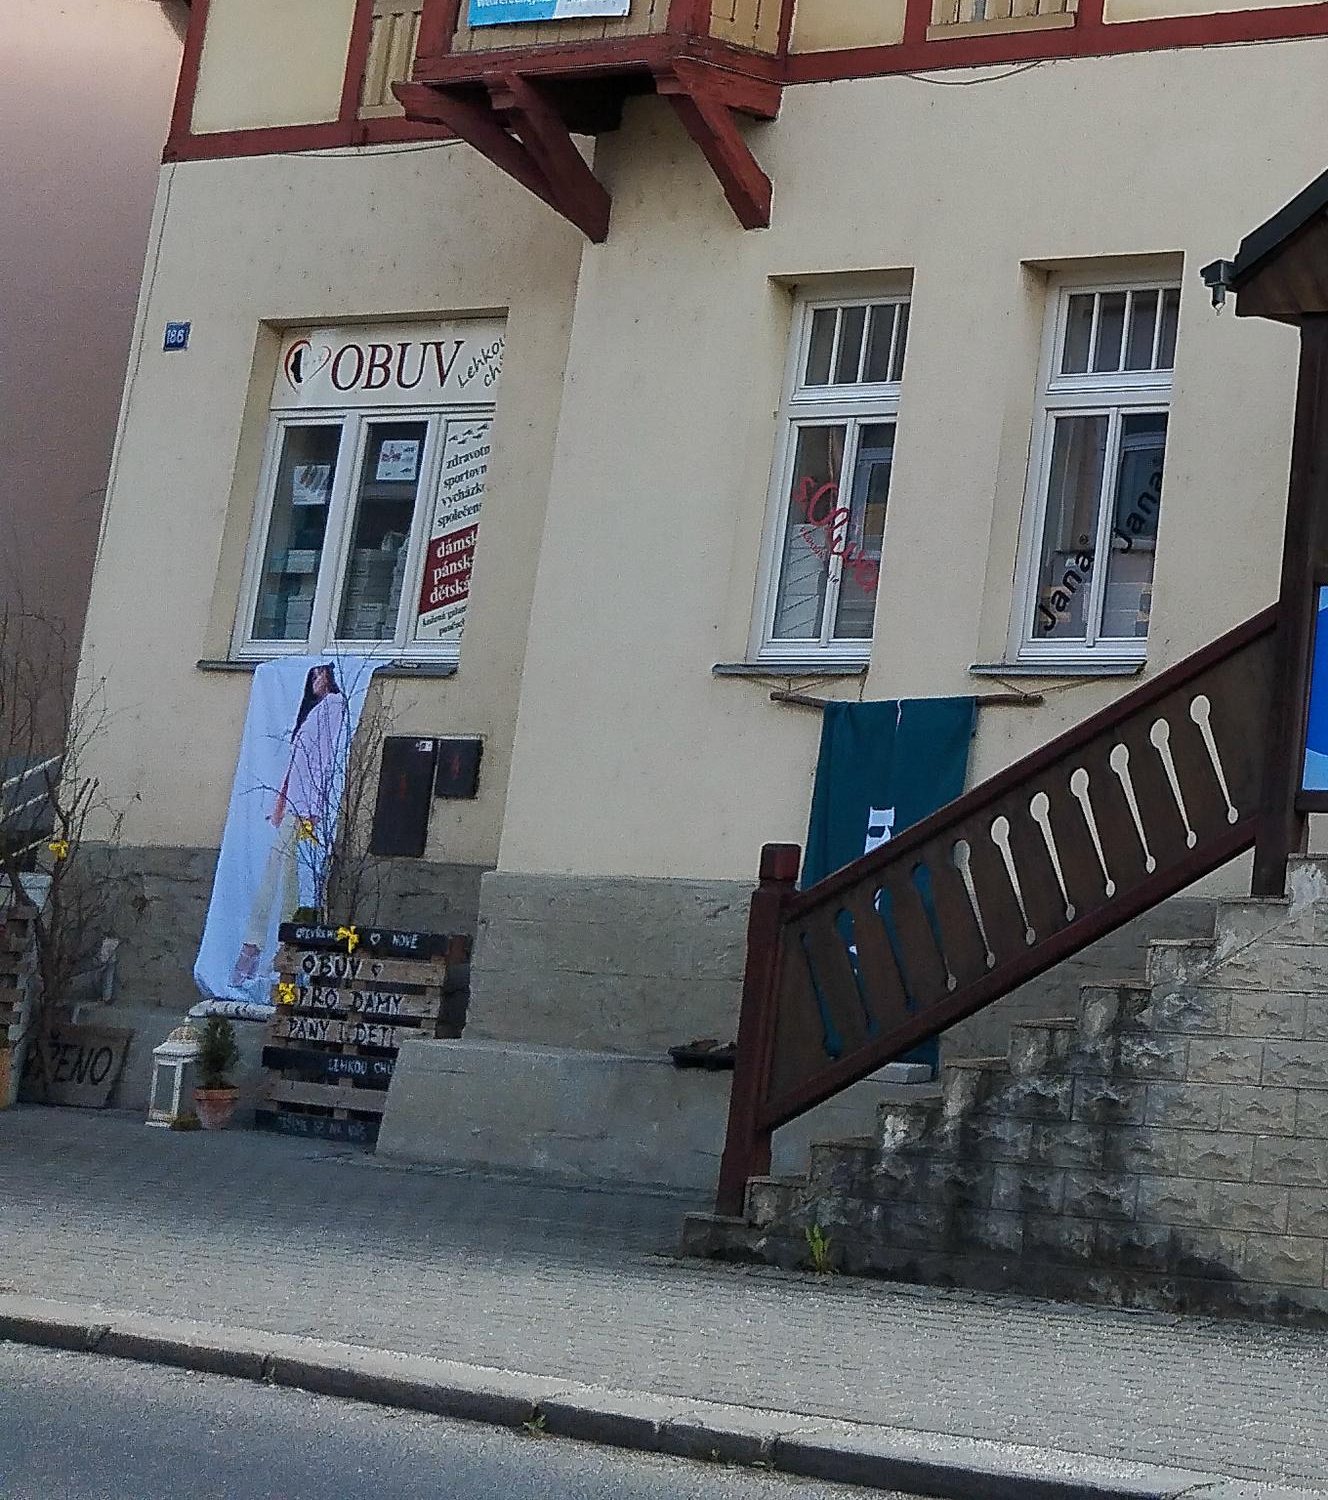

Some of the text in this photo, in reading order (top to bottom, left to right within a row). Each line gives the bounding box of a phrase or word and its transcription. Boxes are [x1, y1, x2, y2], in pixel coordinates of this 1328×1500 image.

[166, 329, 185, 344] 186
[331, 339, 466, 391] OBUV
[441, 483, 485, 509] vycházk
[1038, 551, 1095, 633] Jana
[302, 952, 363, 978] OBUV
[299, 986, 339, 1009] PRO
